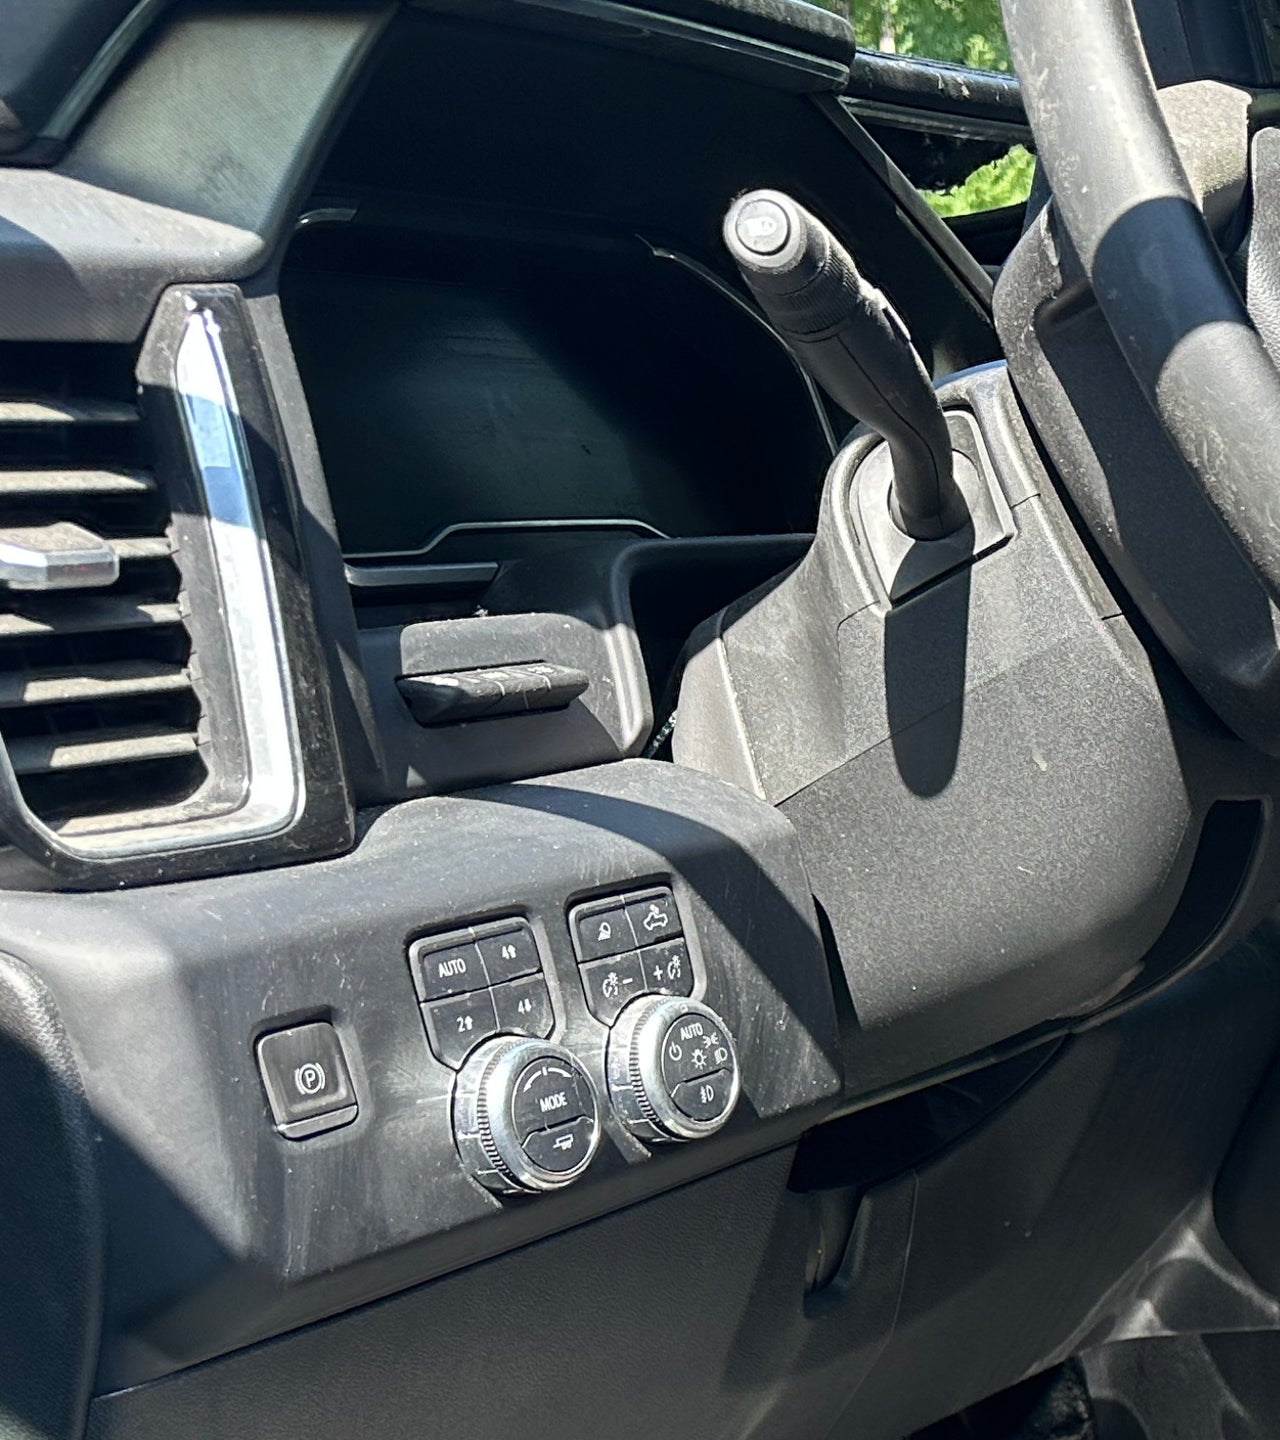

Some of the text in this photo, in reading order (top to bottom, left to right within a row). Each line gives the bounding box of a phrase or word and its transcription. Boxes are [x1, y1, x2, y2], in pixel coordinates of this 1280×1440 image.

[501, 945, 511, 960] 4
[438, 958, 467, 978] AUTO
[517, 1000, 526, 1015] 4
[456, 1017, 466, 1033] 2
[680, 1022, 704, 1041] AUTO
[304, 1069, 316, 1088] P
[539, 1091, 568, 1113] MODE
